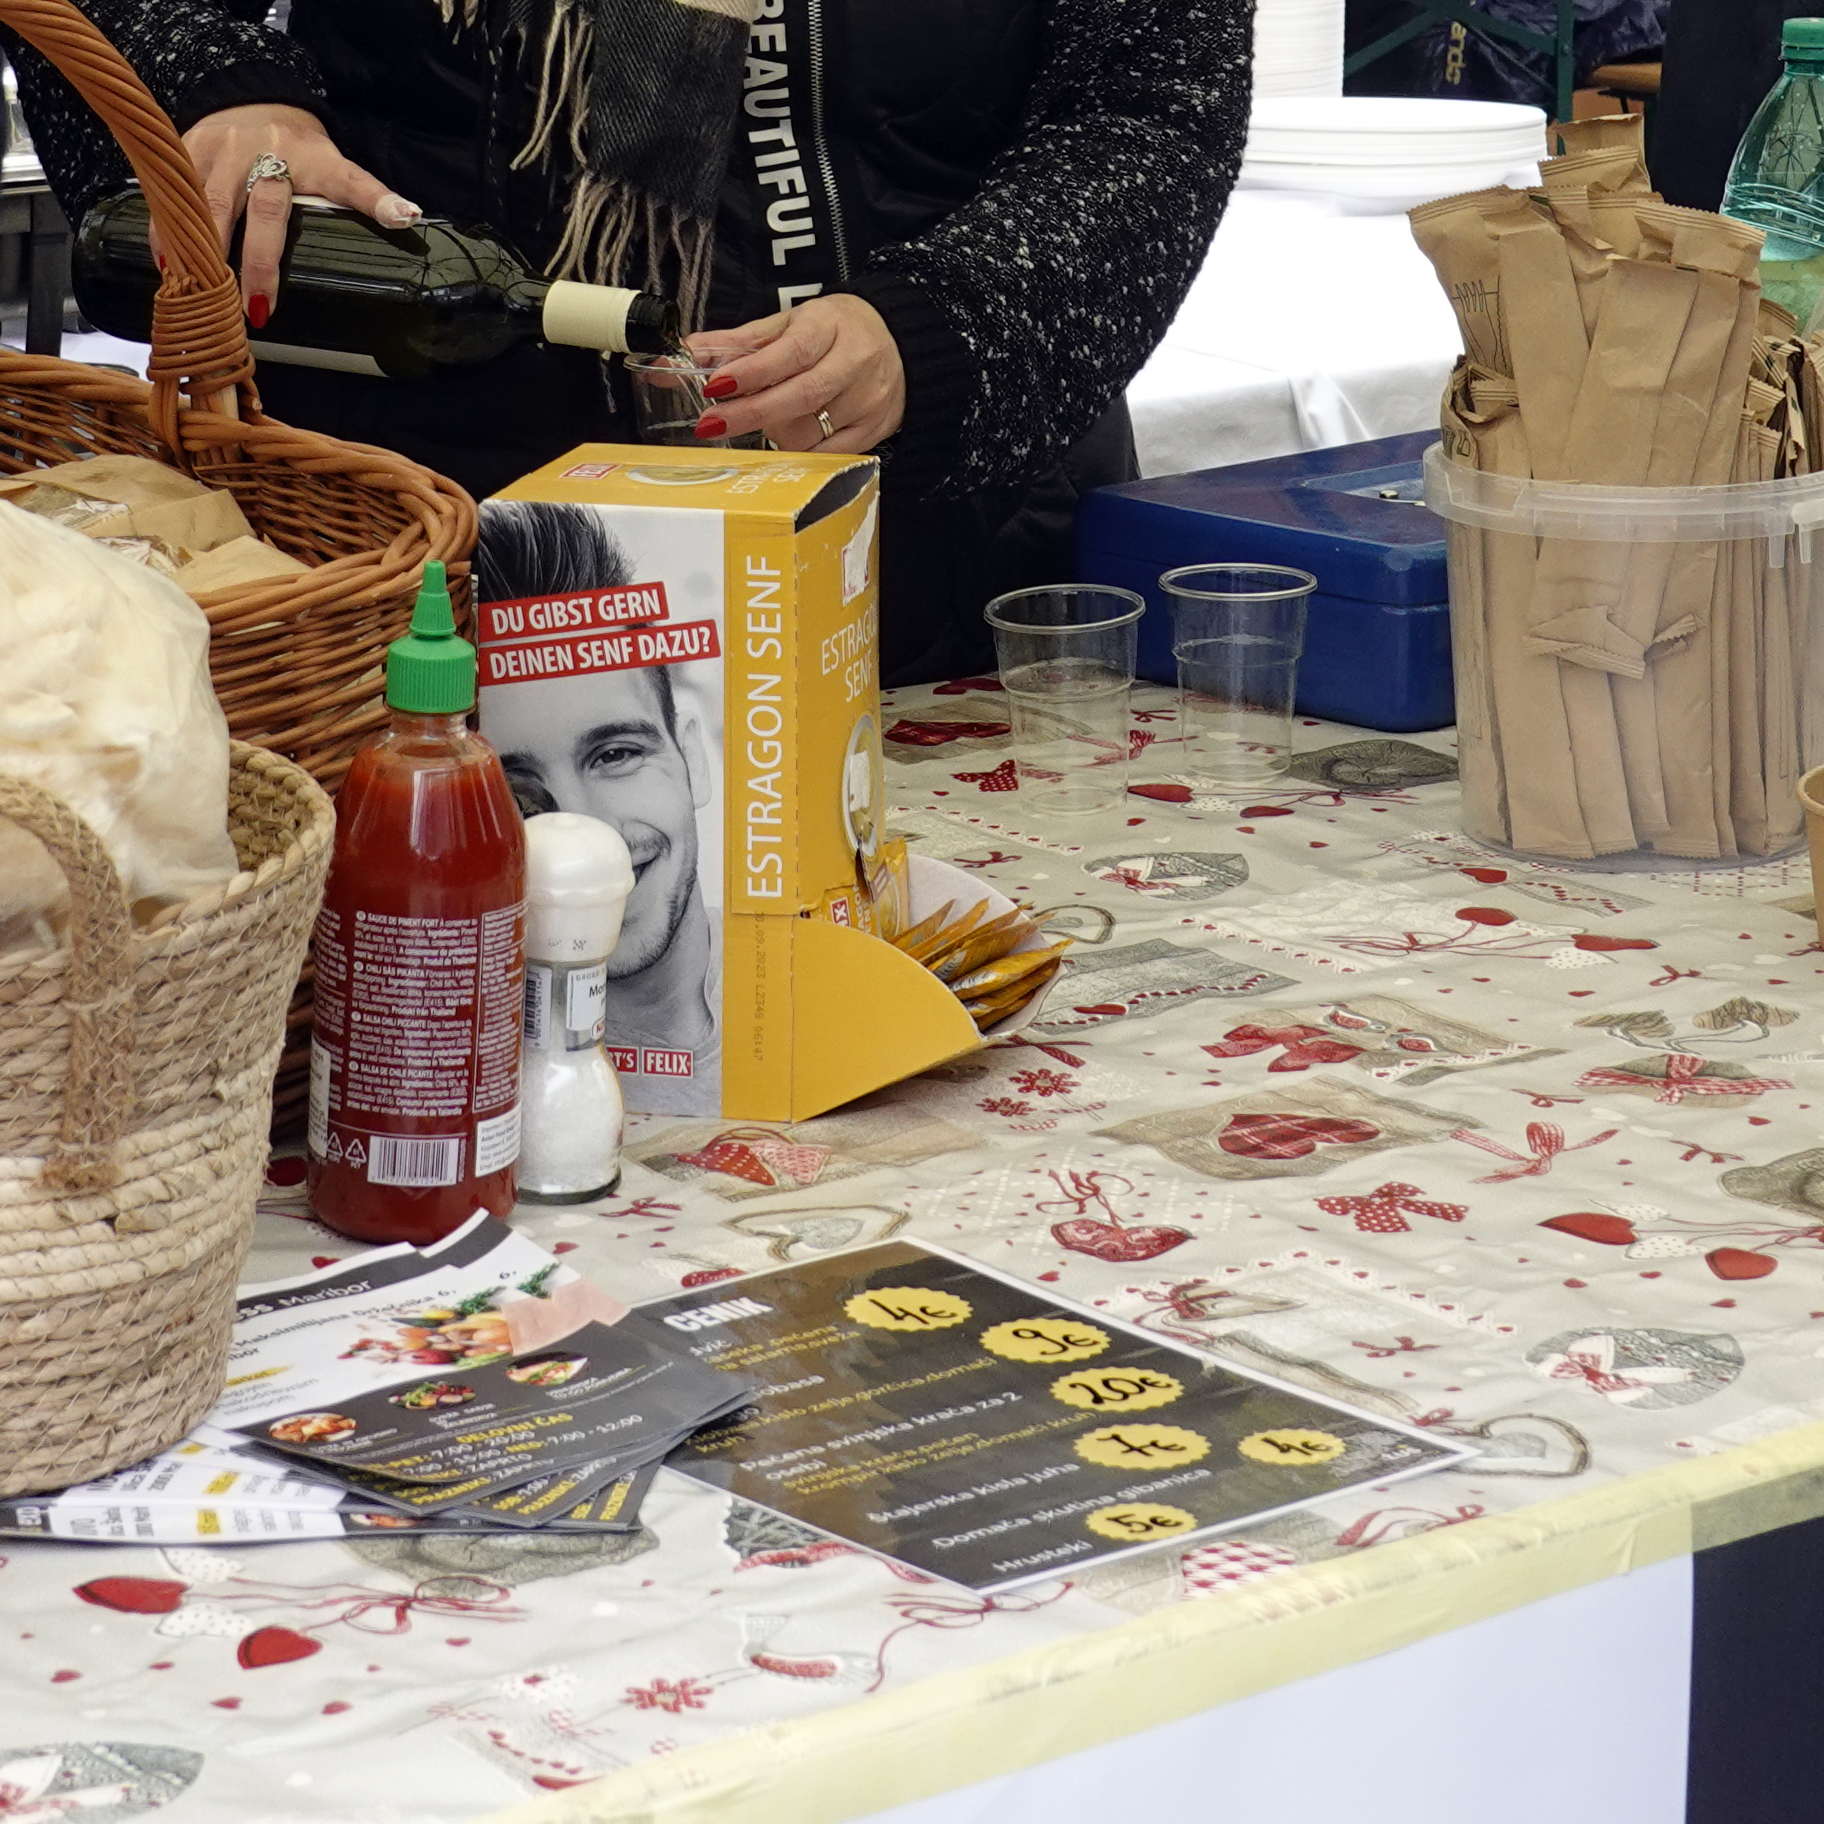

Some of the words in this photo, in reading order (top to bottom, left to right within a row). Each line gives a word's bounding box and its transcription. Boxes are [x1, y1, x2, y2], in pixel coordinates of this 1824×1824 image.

[491, 604, 525, 636] DU
[528, 595, 594, 630] GIBST
[597, 588, 661, 622] GERN
[746, 554, 782, 660] SENF
[489, 645, 575, 680] DEINEN
[578, 637, 635, 669] SENF
[639, 626, 711, 662] DAZU?
[746, 673, 783, 898] ESTRAGON
[646, 1053, 689, 1074] FELIX
[278, 1279, 373, 1309] Maribor
[663, 1296, 774, 1332] CENIK
[868, 1298, 957, 1325] 4€
[1011, 1327, 1102, 1356] 9€
[1068, 1375, 1174, 1405] 20€
[455, 1419, 536, 1444] DELOVNI
[739, 1444, 826, 1472] Pečena
[826, 1420, 914, 1451] svinjska
[911, 1401, 978, 1427] krača
[977, 1397, 1006, 1412] za
[1003, 1390, 1024, 1404] 2
[1095, 1433, 1187, 1458] 7€
[766, 1459, 828, 1481] osebi
[866, 1489, 977, 1526] Štajerska
[971, 1474, 1029, 1497] kisla
[1026, 1460, 1081, 1484] juha
[931, 1516, 1033, 1551] Domača
[1029, 1492, 1115, 1528] skutina
[1115, 1467, 1214, 1504] gibanica
[1118, 1512, 1183, 1535] 5€
